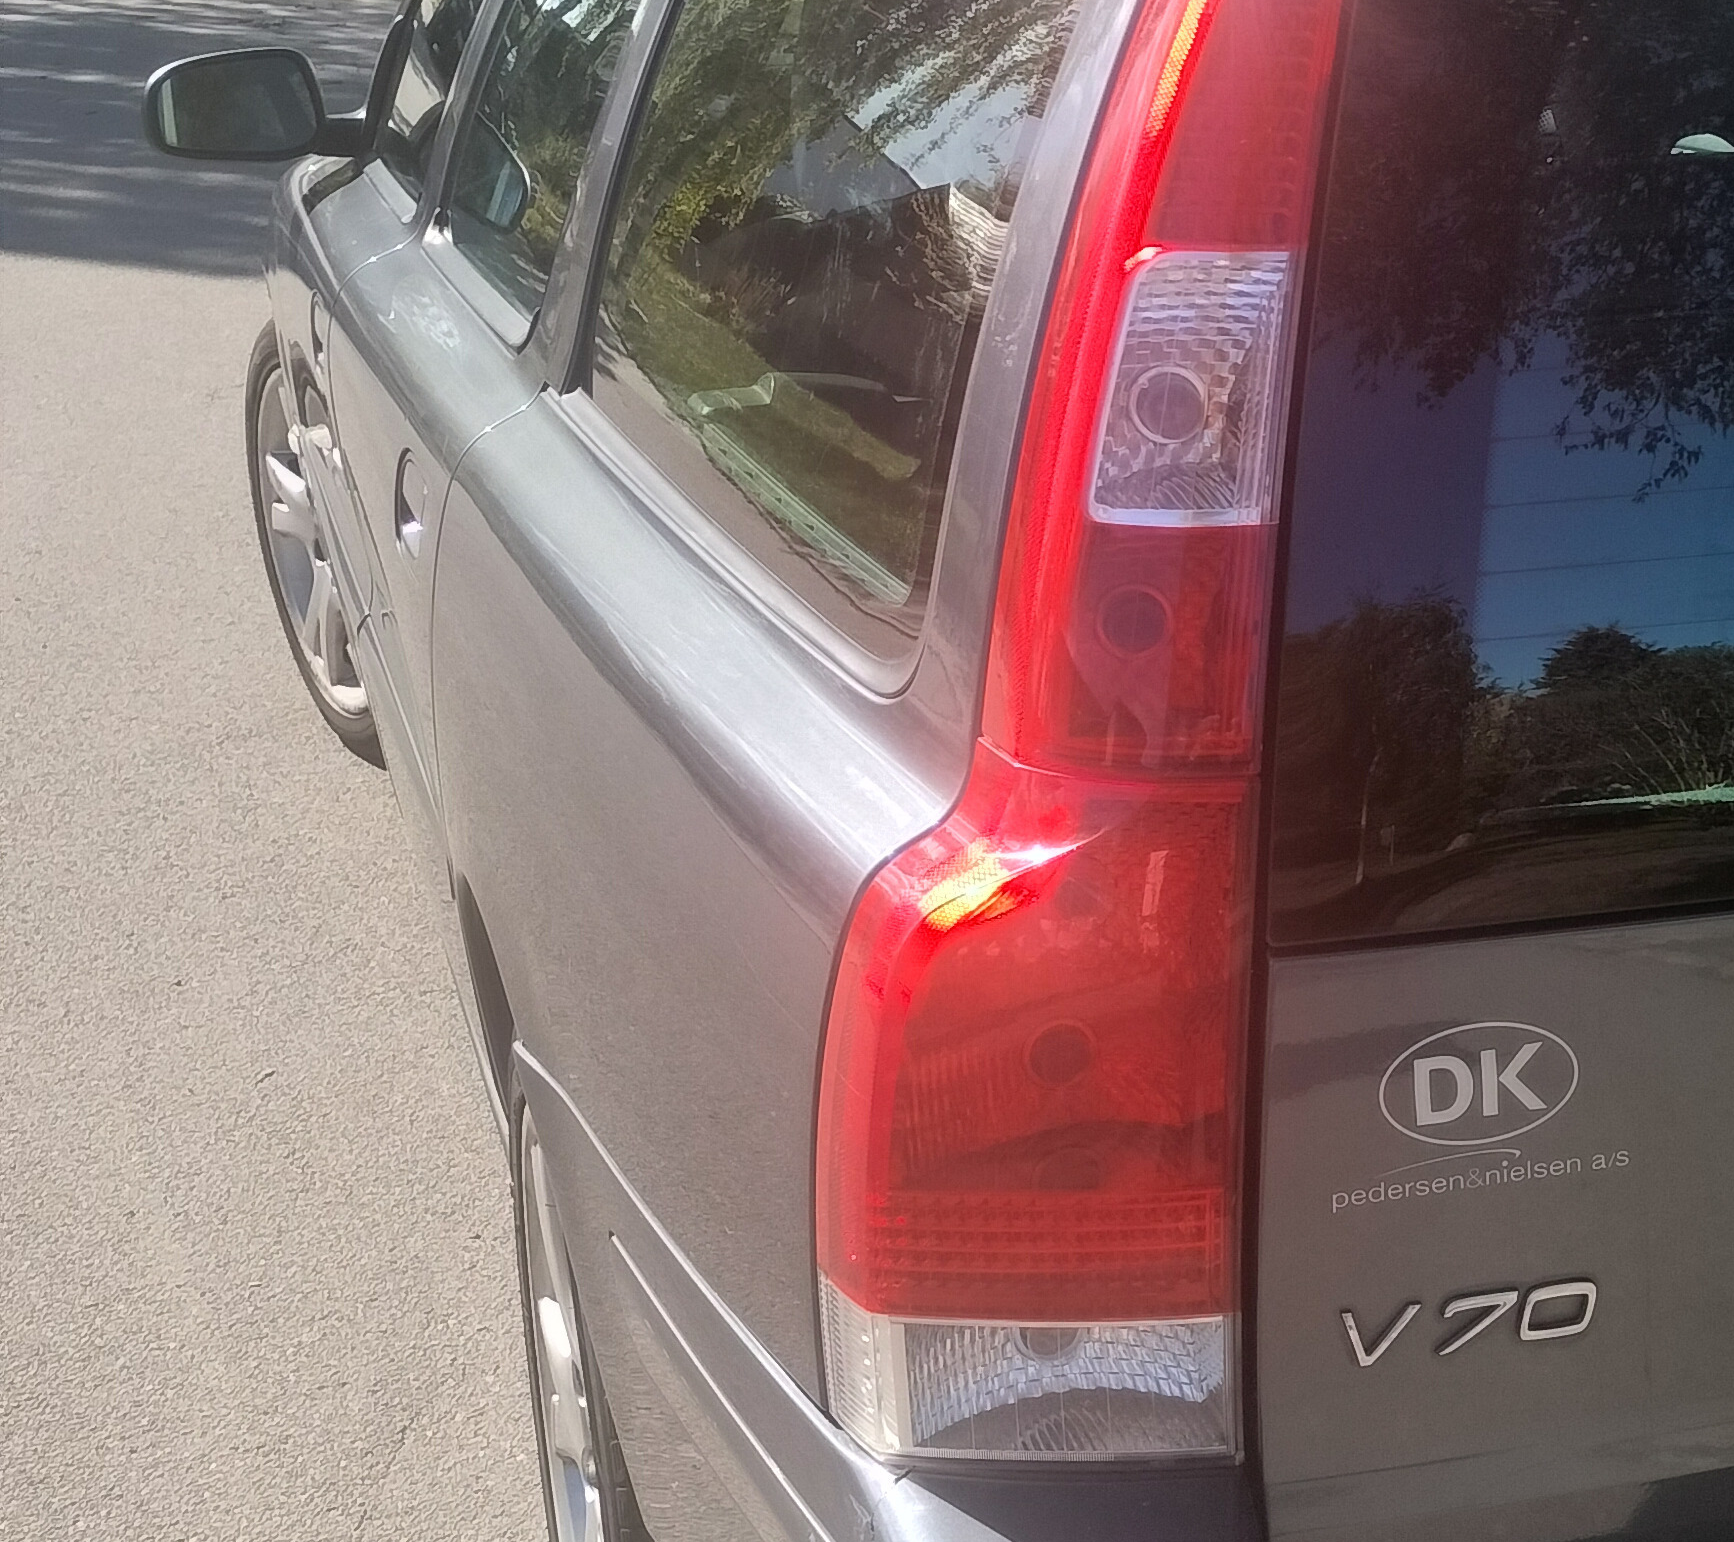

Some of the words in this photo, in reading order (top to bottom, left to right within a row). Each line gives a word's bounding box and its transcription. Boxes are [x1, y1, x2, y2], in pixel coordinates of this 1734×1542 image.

[1412, 1040, 1548, 1127] DK
[1331, 1157, 1582, 1214] pedersen&nielsen
[1590, 1148, 1631, 1171] a/s
